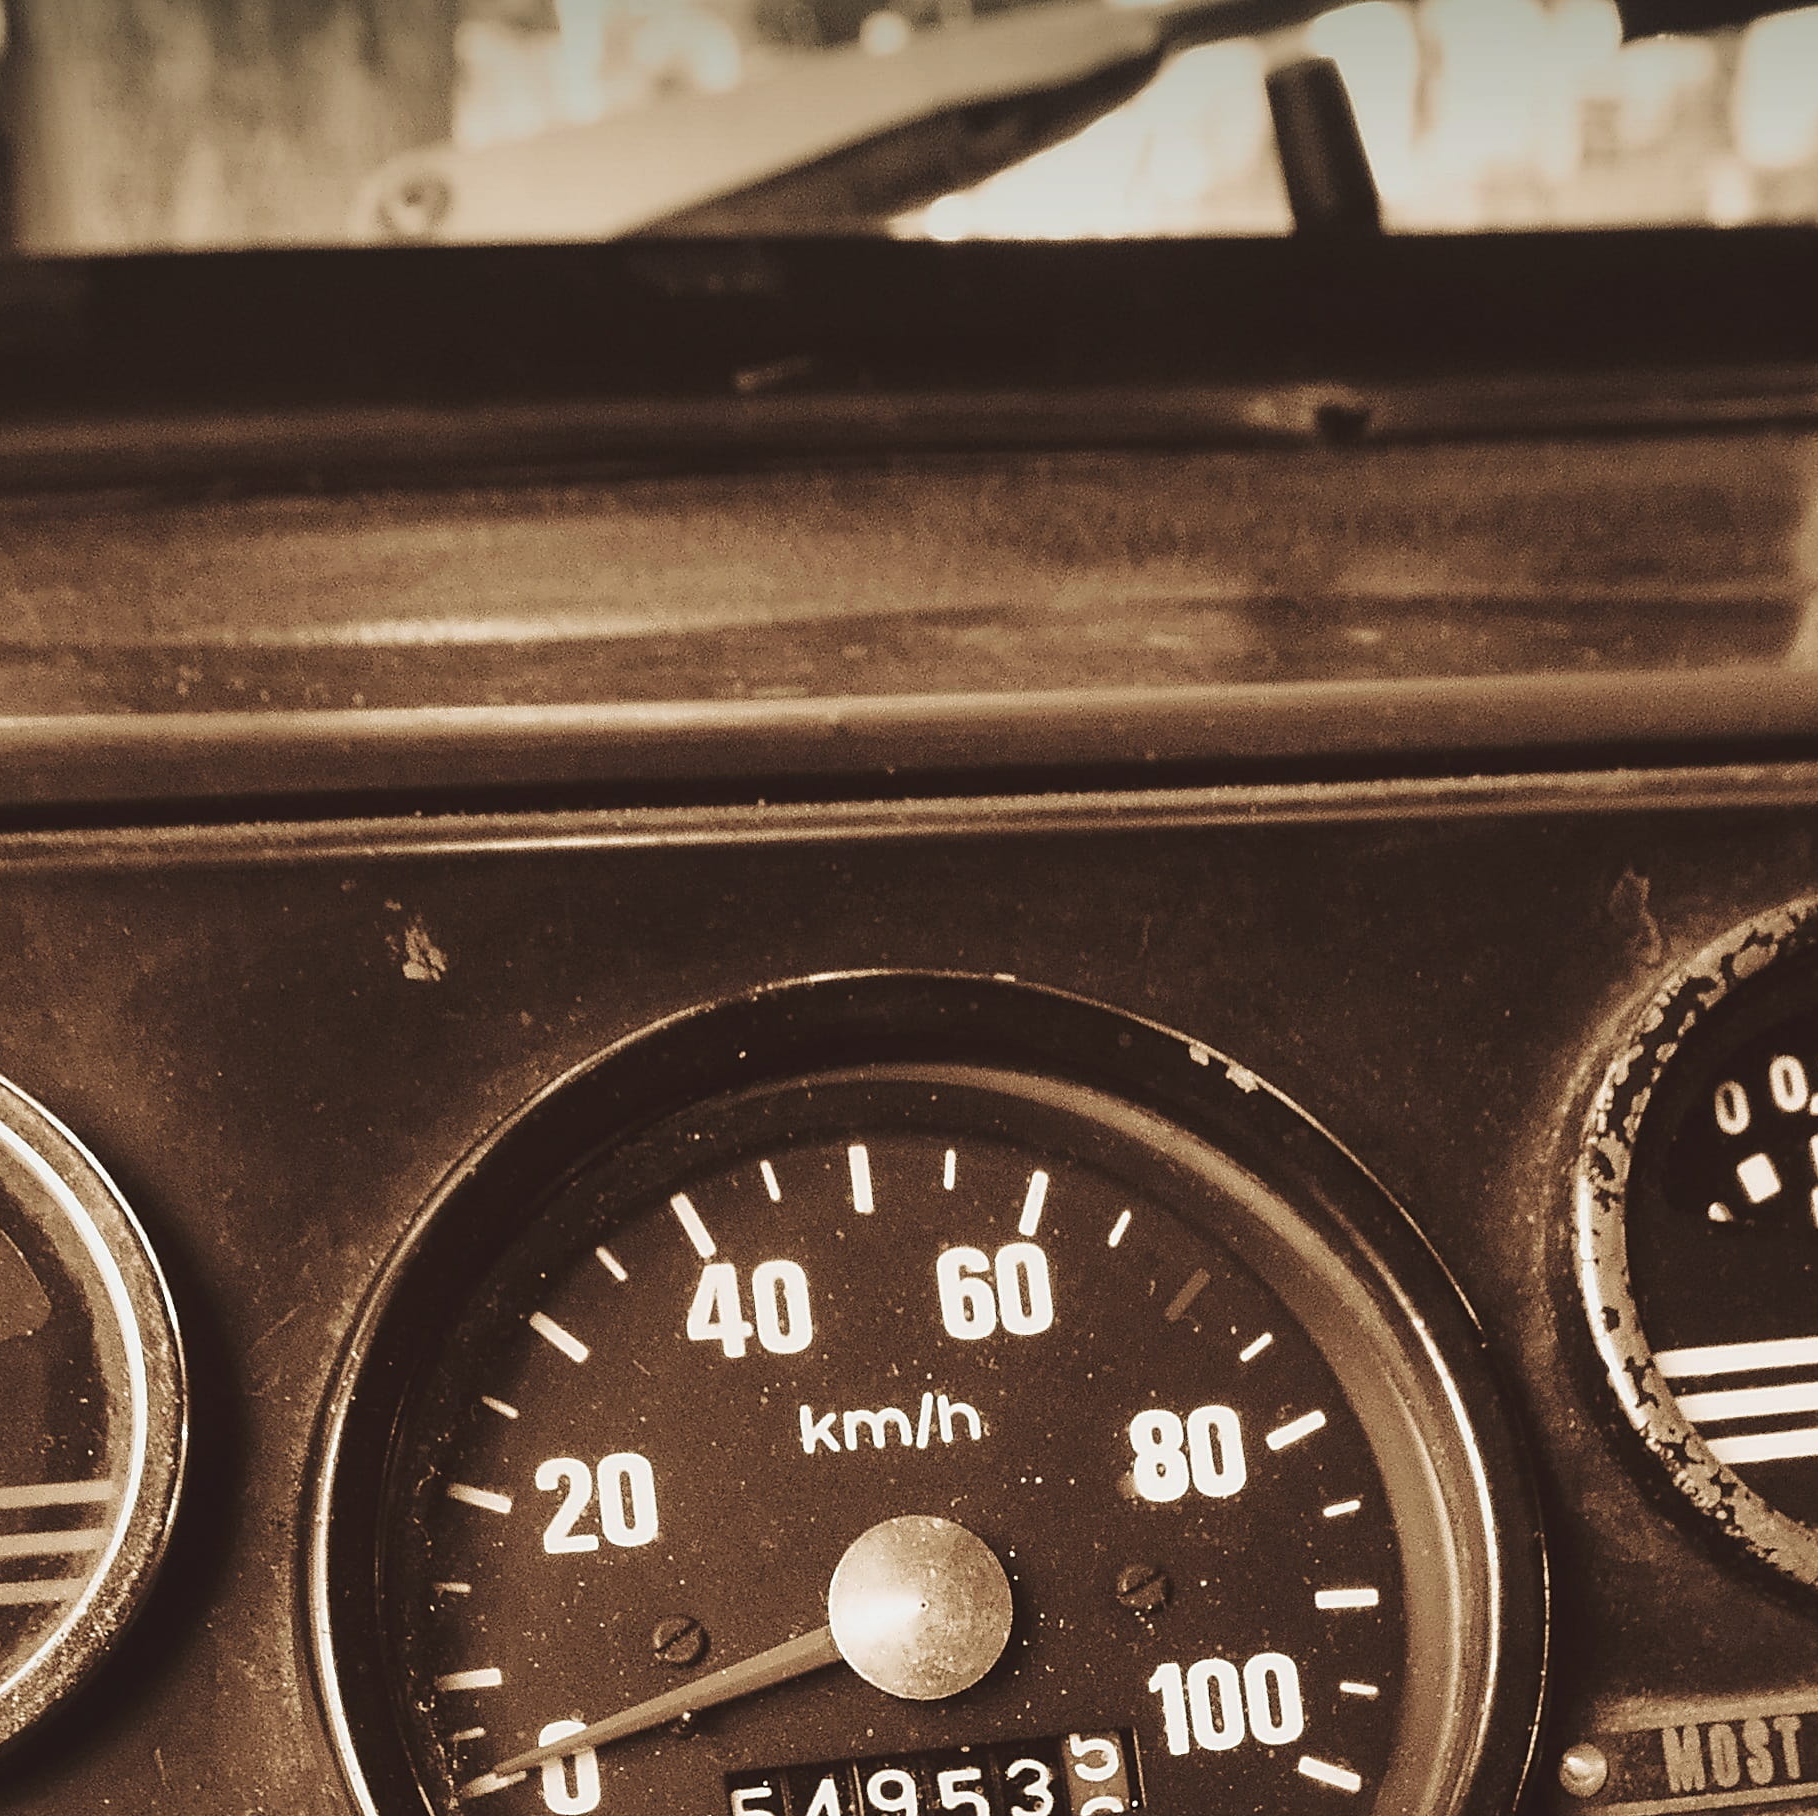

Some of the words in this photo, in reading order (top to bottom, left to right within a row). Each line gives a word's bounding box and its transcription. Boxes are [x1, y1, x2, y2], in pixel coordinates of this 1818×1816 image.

[1715, 1081, 1750, 1134] 0
[687, 1260, 814, 1358] 40
[936, 1242, 1054, 1341] 60
[799, 1391, 982, 1455] km/h
[1128, 1405, 1247, 1503] 80
[535, 1452, 659, 1554] 20
[1148, 1652, 1304, 1756] 100
[537, 1719, 602, 1816] 0
[1662, 1714, 1801, 1793] MOST
